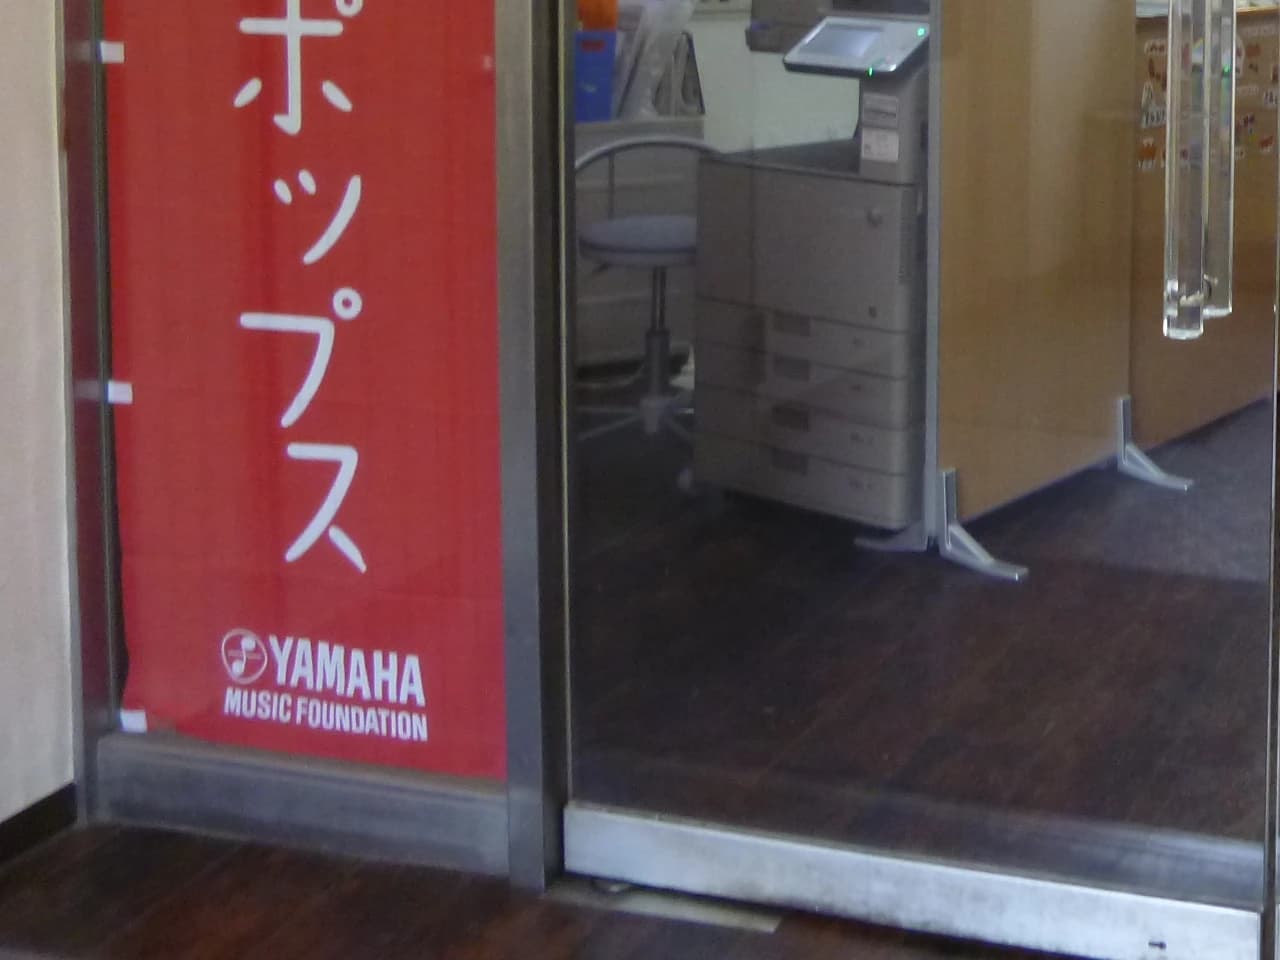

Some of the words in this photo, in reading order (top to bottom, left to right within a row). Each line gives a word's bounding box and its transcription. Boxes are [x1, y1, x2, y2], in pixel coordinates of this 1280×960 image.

[268, 634, 427, 708] YAMAHA
[223, 686, 293, 724] MUSIC
[296, 696, 429, 743] FOUNDATION
